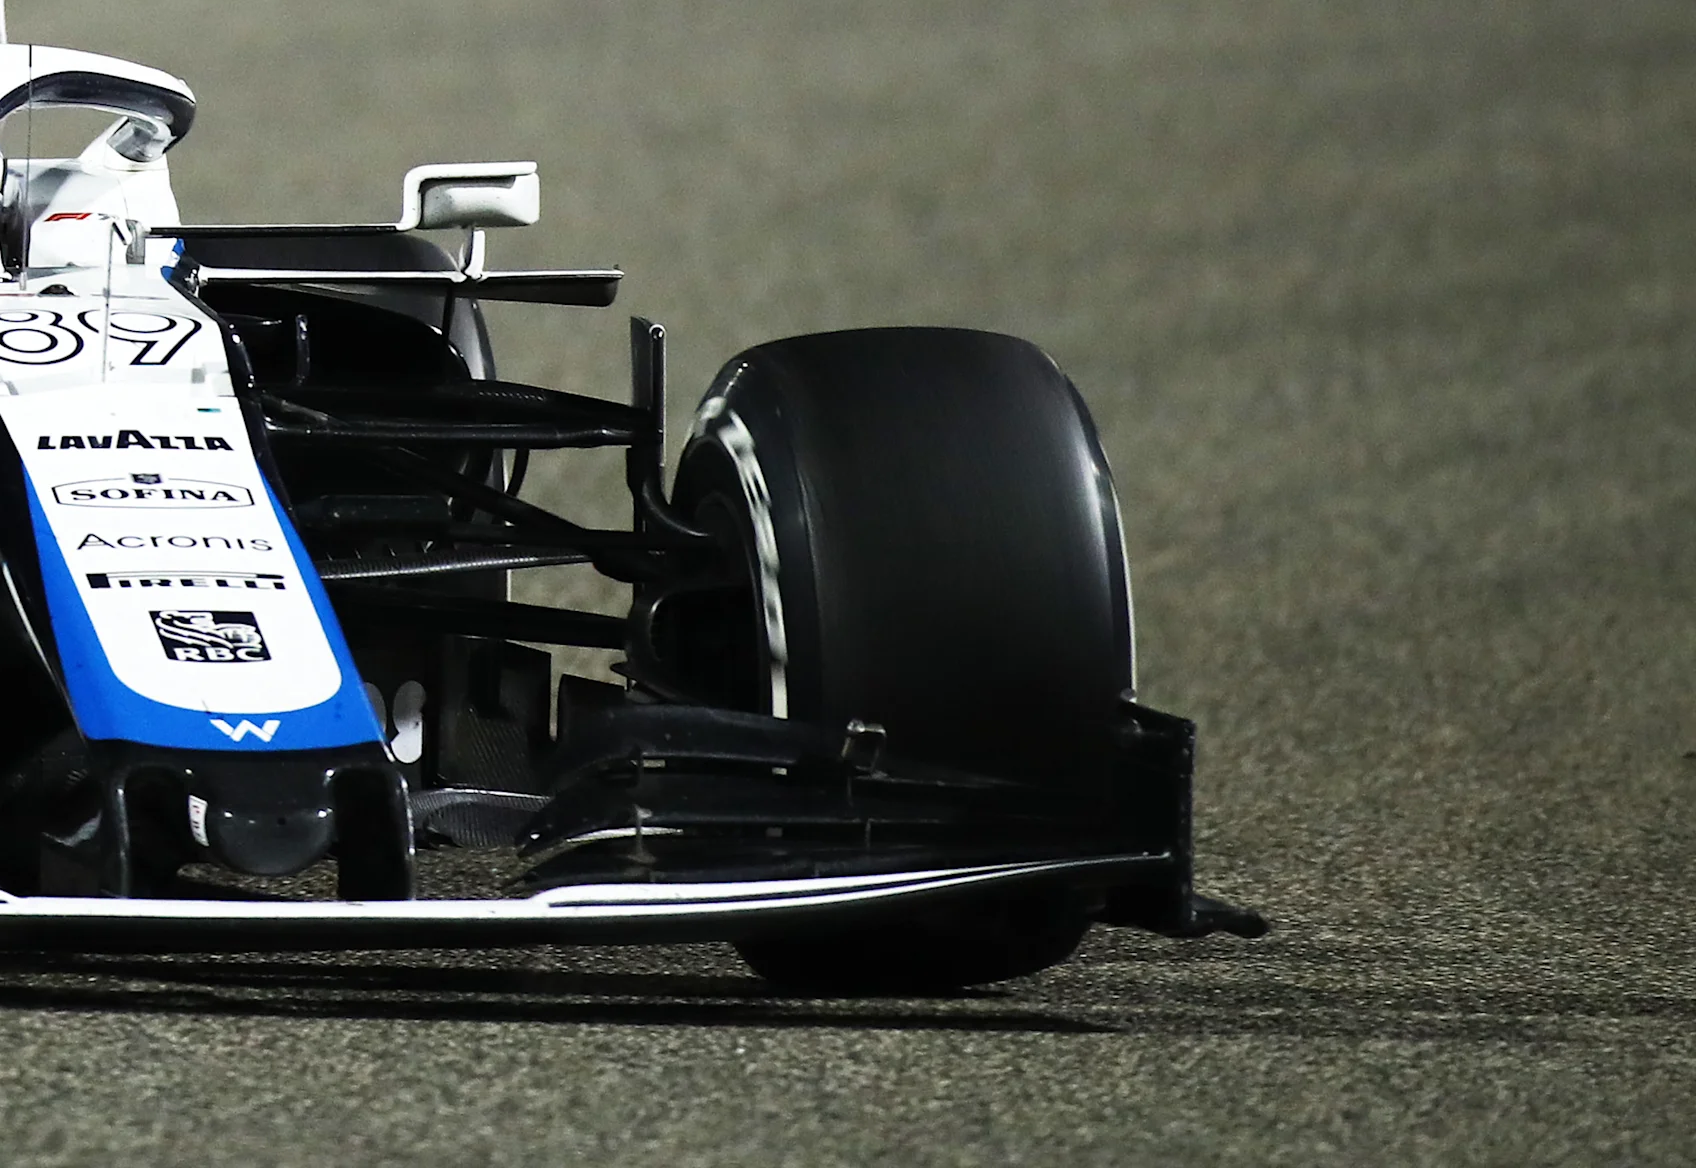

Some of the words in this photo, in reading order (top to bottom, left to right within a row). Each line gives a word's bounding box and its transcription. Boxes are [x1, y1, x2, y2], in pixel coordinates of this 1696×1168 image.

[37, 429, 234, 451] LAVAZZA
[70, 488, 240, 502] SOFINA
[77, 533, 273, 552] Acronis
[86, 570, 287, 590] PIRELLI
[173, 647, 266, 662] RBC
[209, 719, 281, 743] W
